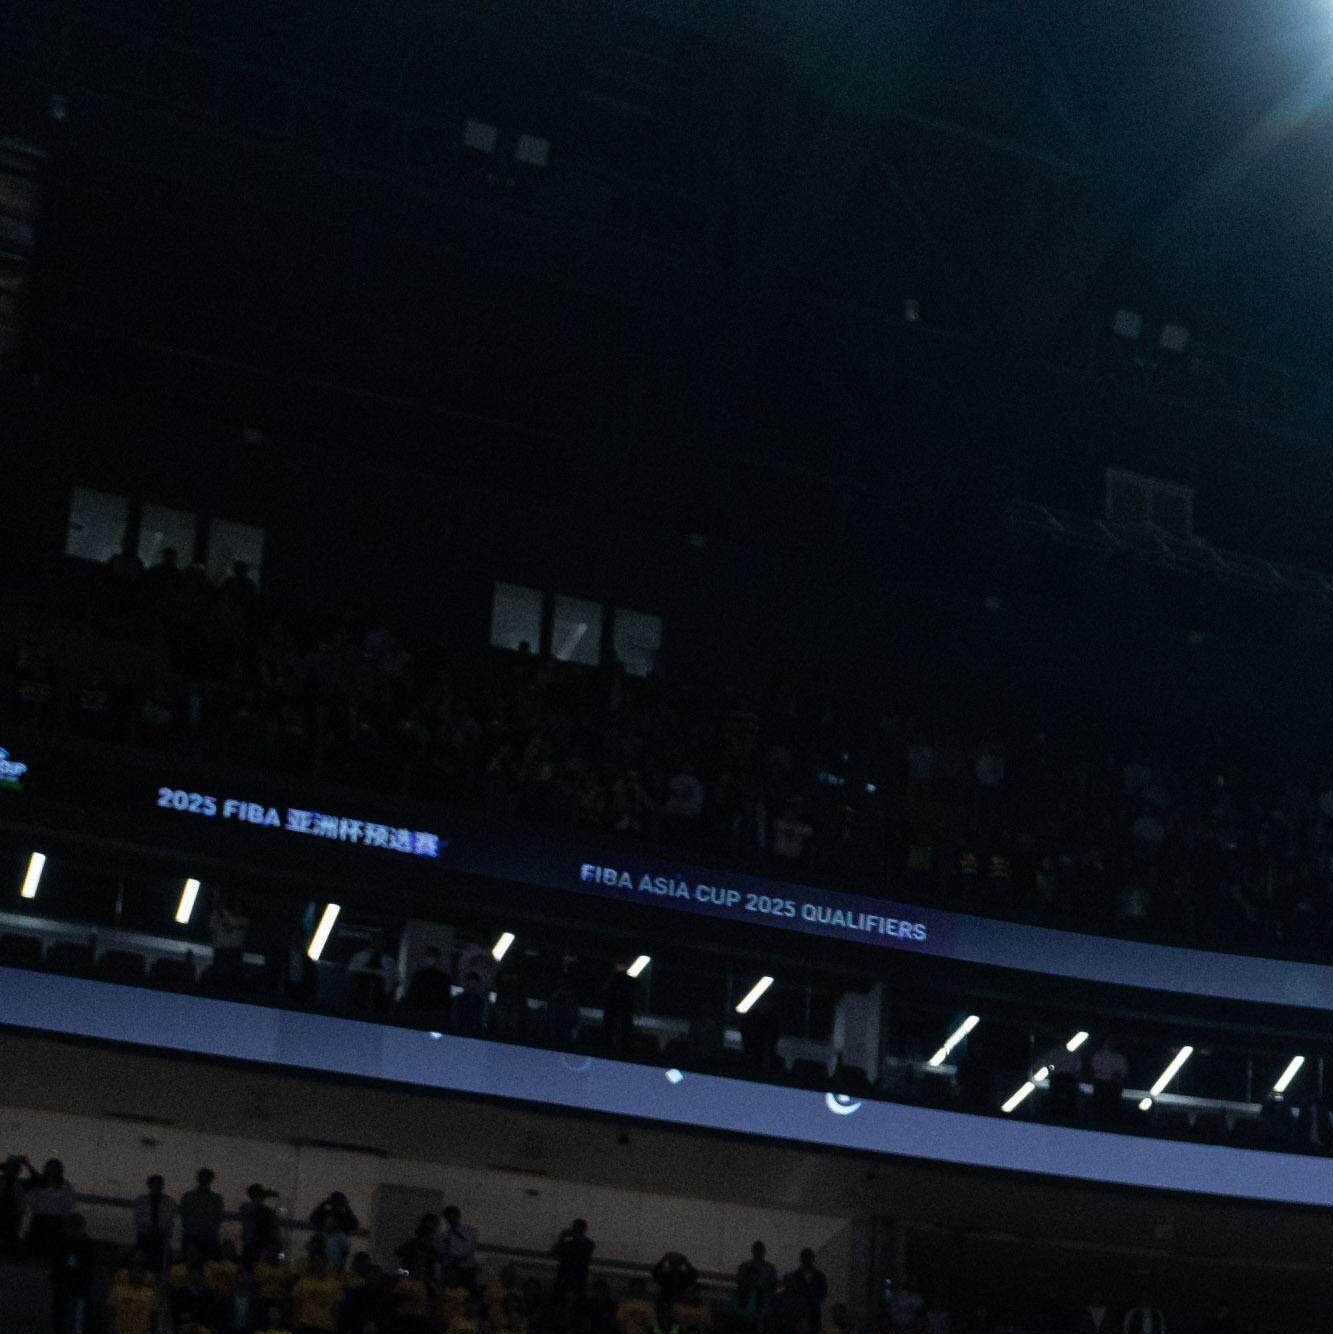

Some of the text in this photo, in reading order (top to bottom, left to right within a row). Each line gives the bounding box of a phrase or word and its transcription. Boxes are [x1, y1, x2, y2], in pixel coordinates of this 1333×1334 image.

[158, 787, 440, 858] 2025 FIBA 亚洲杯预选赛
[580, 863, 927, 942] FIBA ASIA CUP 2025 QUALIFIERS
